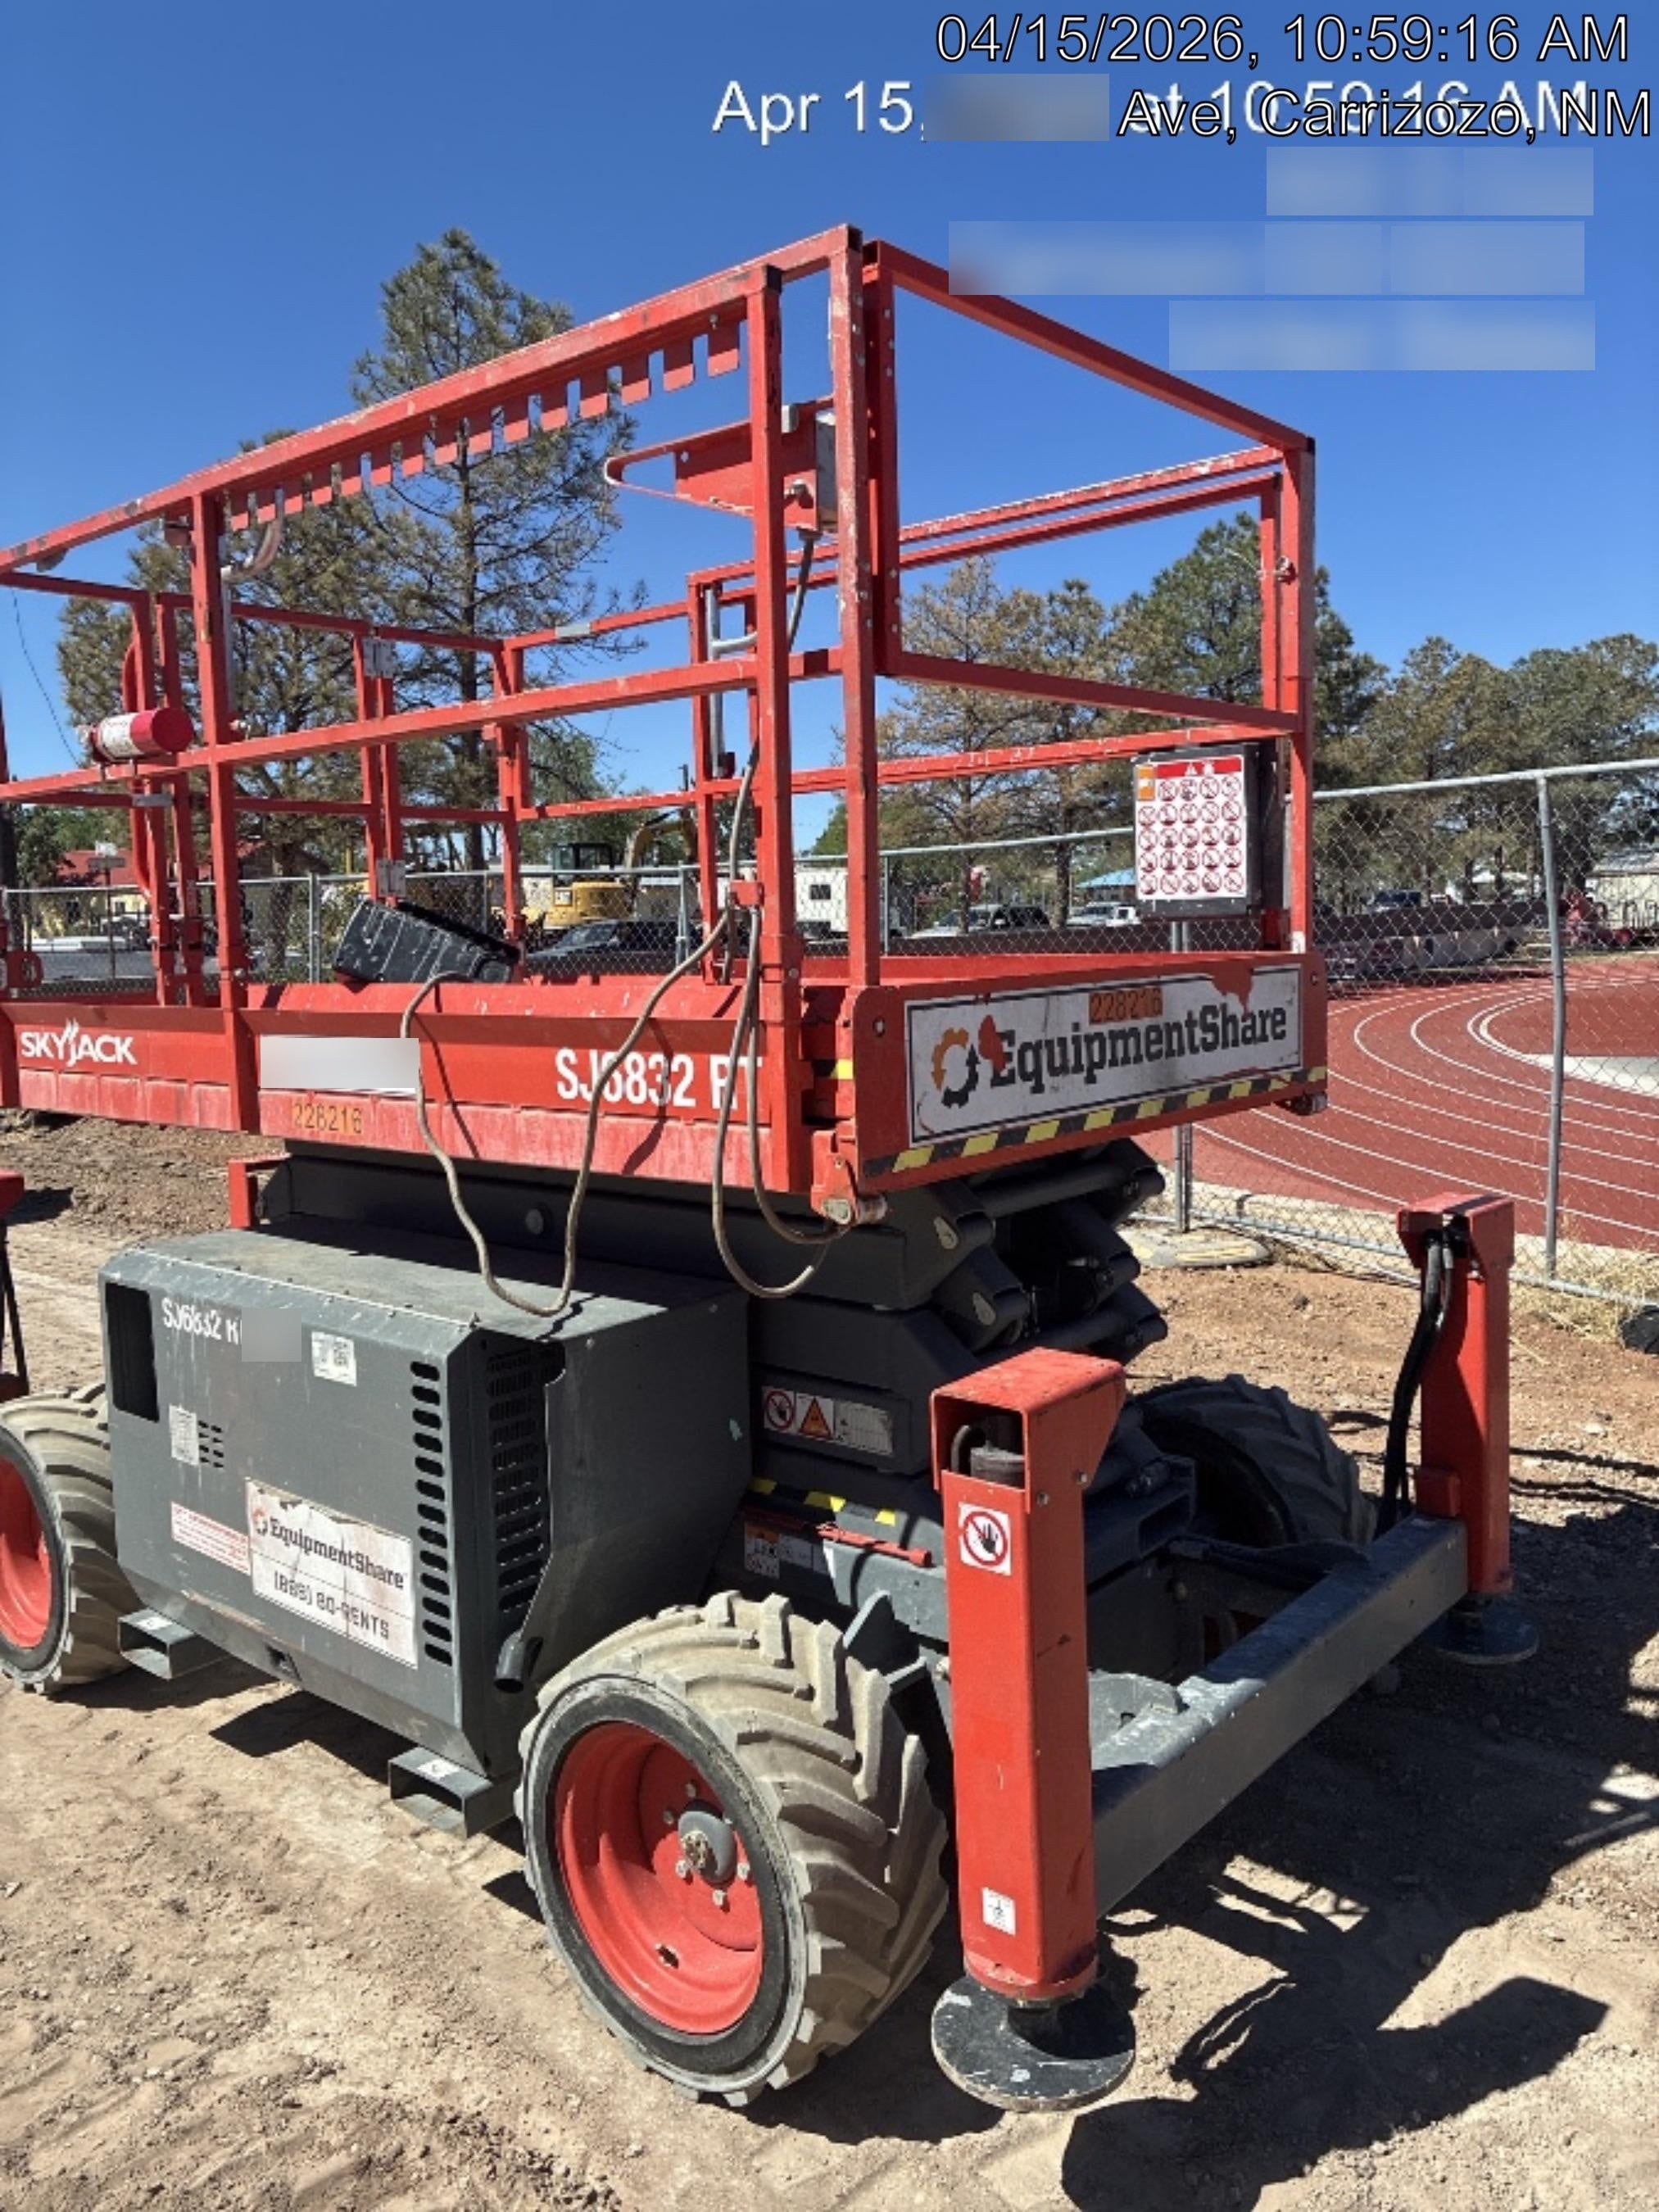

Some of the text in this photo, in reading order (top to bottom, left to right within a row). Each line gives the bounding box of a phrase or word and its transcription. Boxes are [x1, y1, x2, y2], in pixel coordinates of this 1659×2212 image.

[20, 1018, 137, 1066] SKYJACK
[990, 1002, 1287, 1094] EquipmentShare
[555, 1046, 696, 1108] SJ6832
[269, 1516, 406, 1590] EquipmentShare
